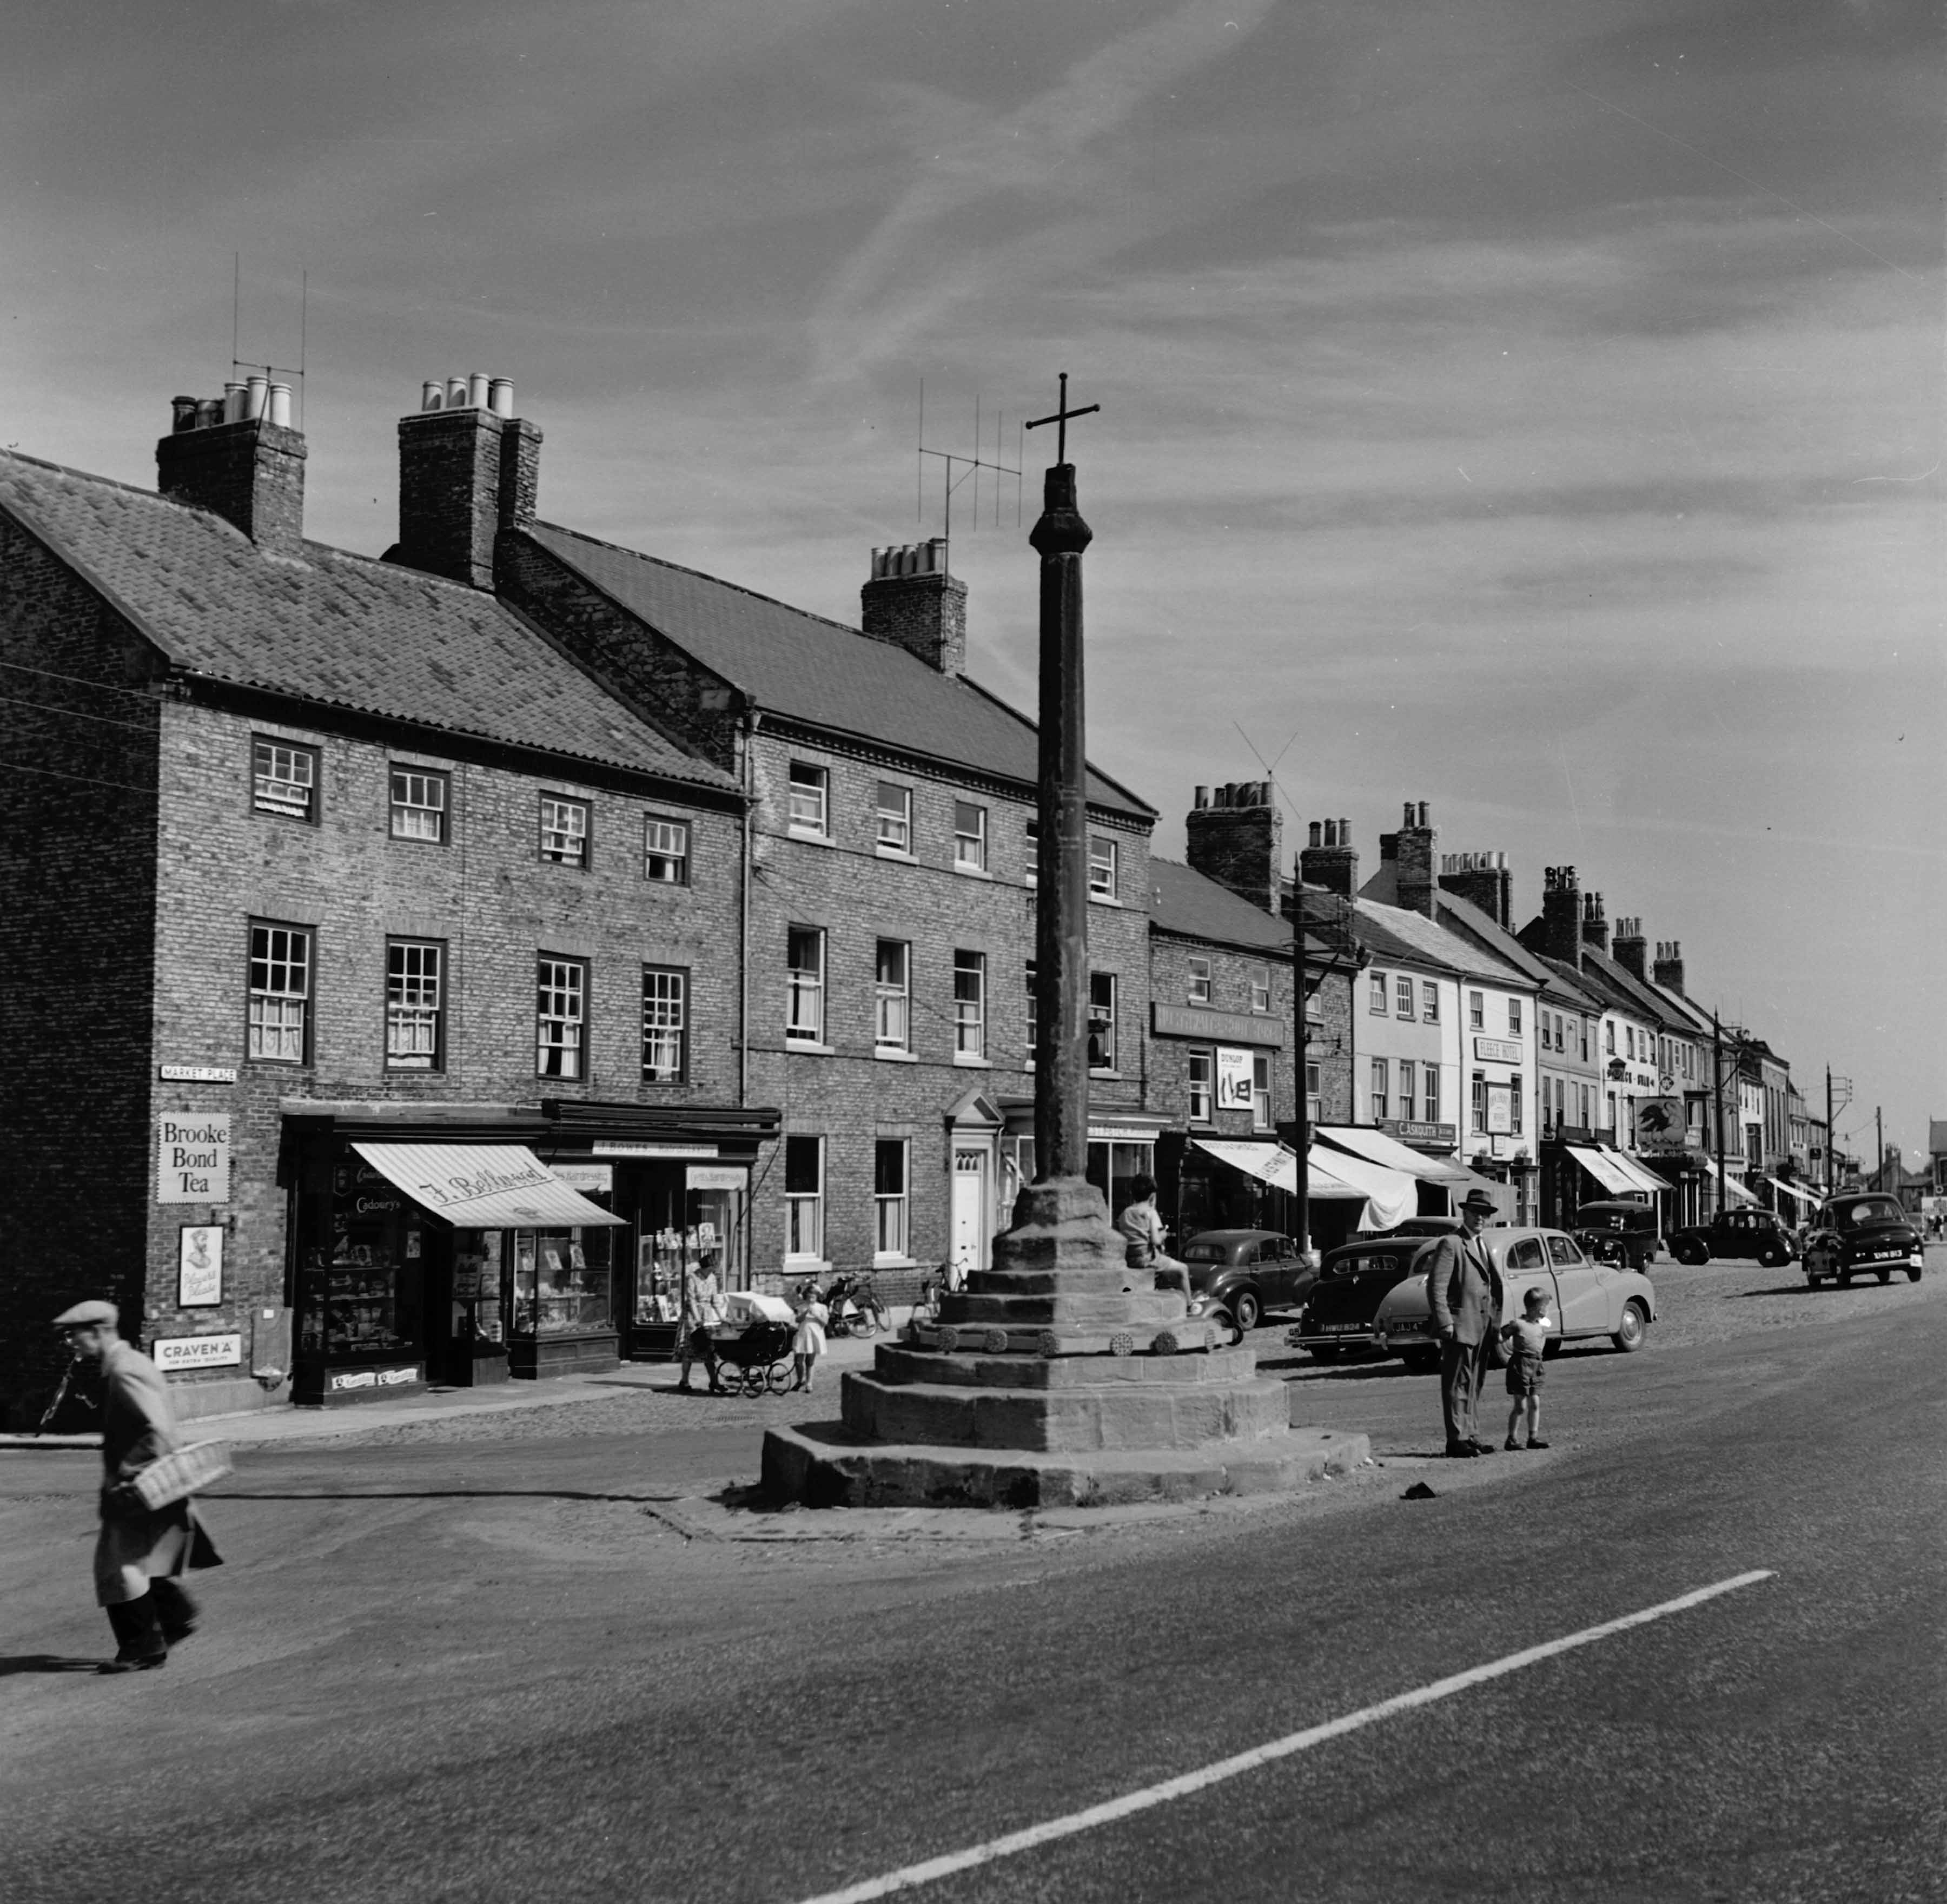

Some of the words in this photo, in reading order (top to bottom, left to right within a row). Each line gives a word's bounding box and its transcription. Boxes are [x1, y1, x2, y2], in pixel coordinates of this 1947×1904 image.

[1480, 1041, 1500, 1057] FLEECE
[1502, 1045, 1519, 1060] HOTEL
[164, 1067, 203, 1079] MARKET
[207, 1069, 234, 1081] PLACE
[164, 1122, 227, 1143] Brooke
[173, 1147, 218, 1168] Bond
[178, 1172, 209, 1193] Tea
[163, 1343, 218, 1358] CRAVEN
